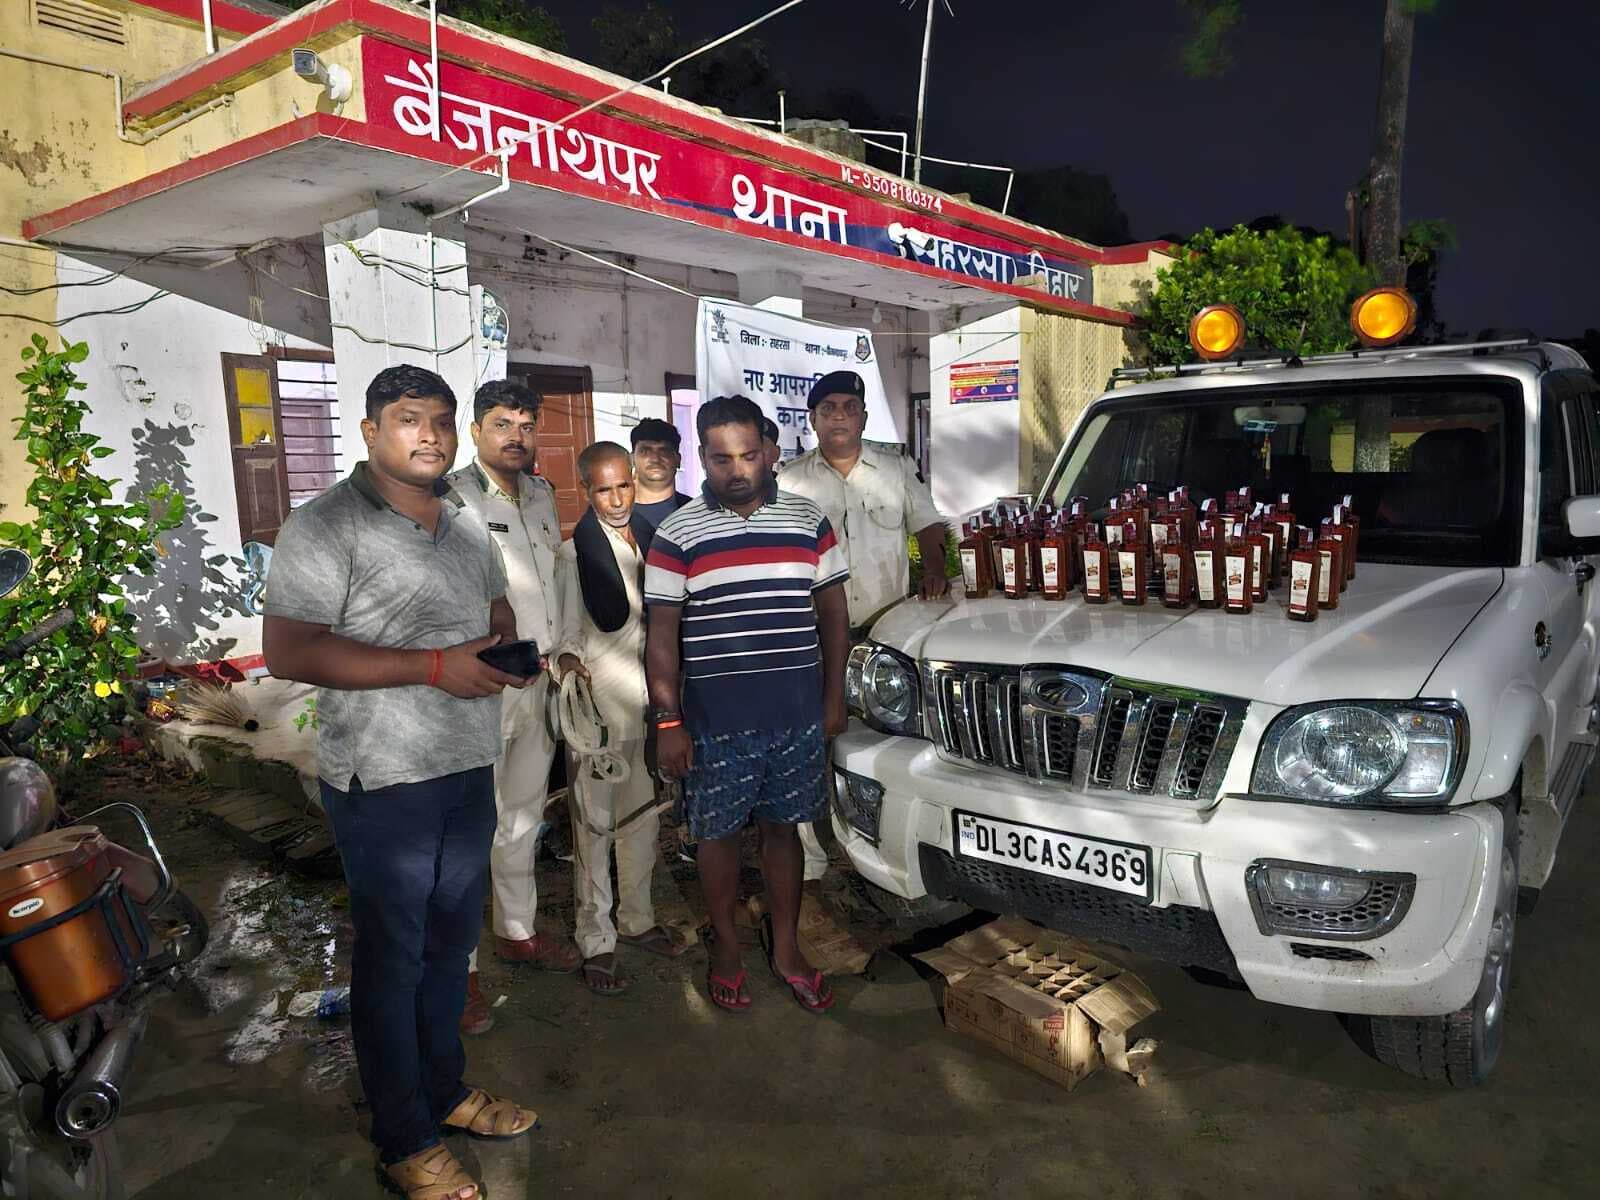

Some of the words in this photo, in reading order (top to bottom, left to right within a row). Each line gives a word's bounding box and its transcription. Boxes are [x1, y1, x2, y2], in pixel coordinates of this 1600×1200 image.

[731, 174, 848, 245] थाना
[740, 330, 760, 346] जिला
[743, 369, 764, 392] नए
[769, 373, 824, 396] आपरा
[776, 406, 811, 435] कानू
[961, 830, 975, 840] IND
[976, 824, 1145, 886] DL3CAS4369
